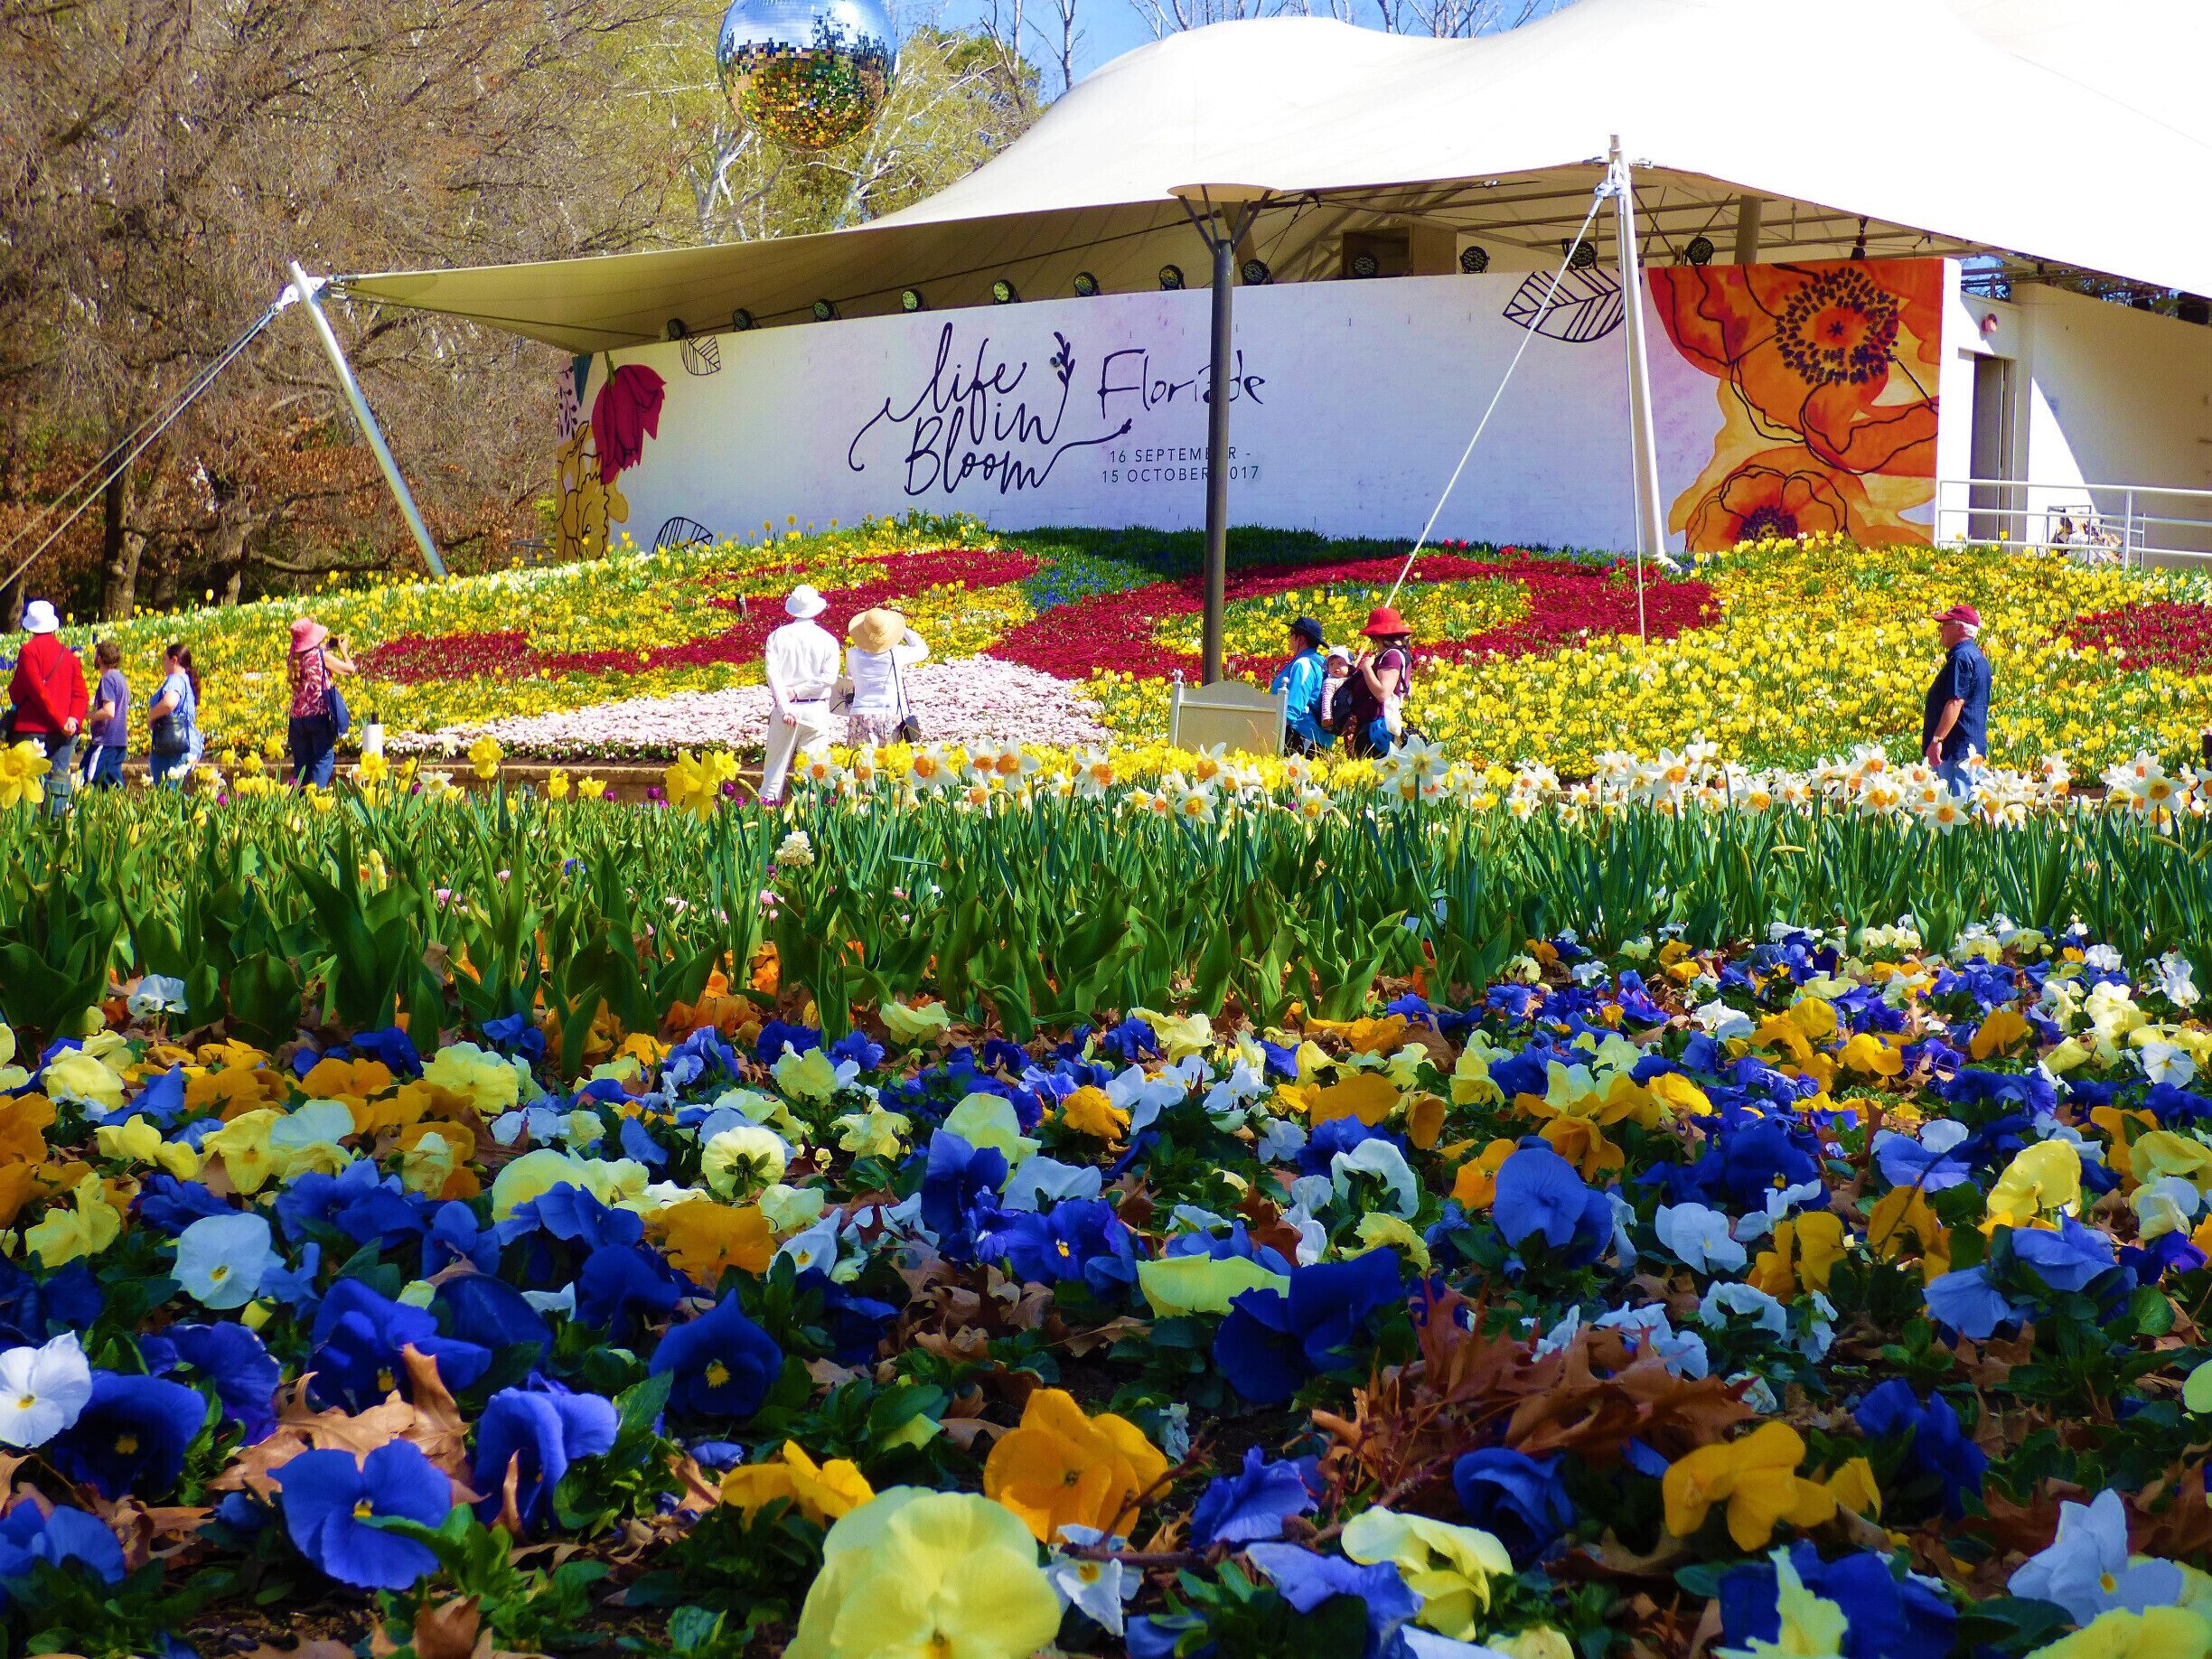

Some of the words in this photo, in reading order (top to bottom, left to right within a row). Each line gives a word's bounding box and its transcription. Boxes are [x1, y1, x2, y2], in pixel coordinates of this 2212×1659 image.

[904, 406, 1059, 496] Bloom
[1110, 450, 1126, 463] 16
[1135, 446, 1236, 463] SEPTEMR
[1101, 470, 1119, 483] 15
[1127, 467, 1209, 483] OCTOBER
[1230, 465, 1259, 480] 017
